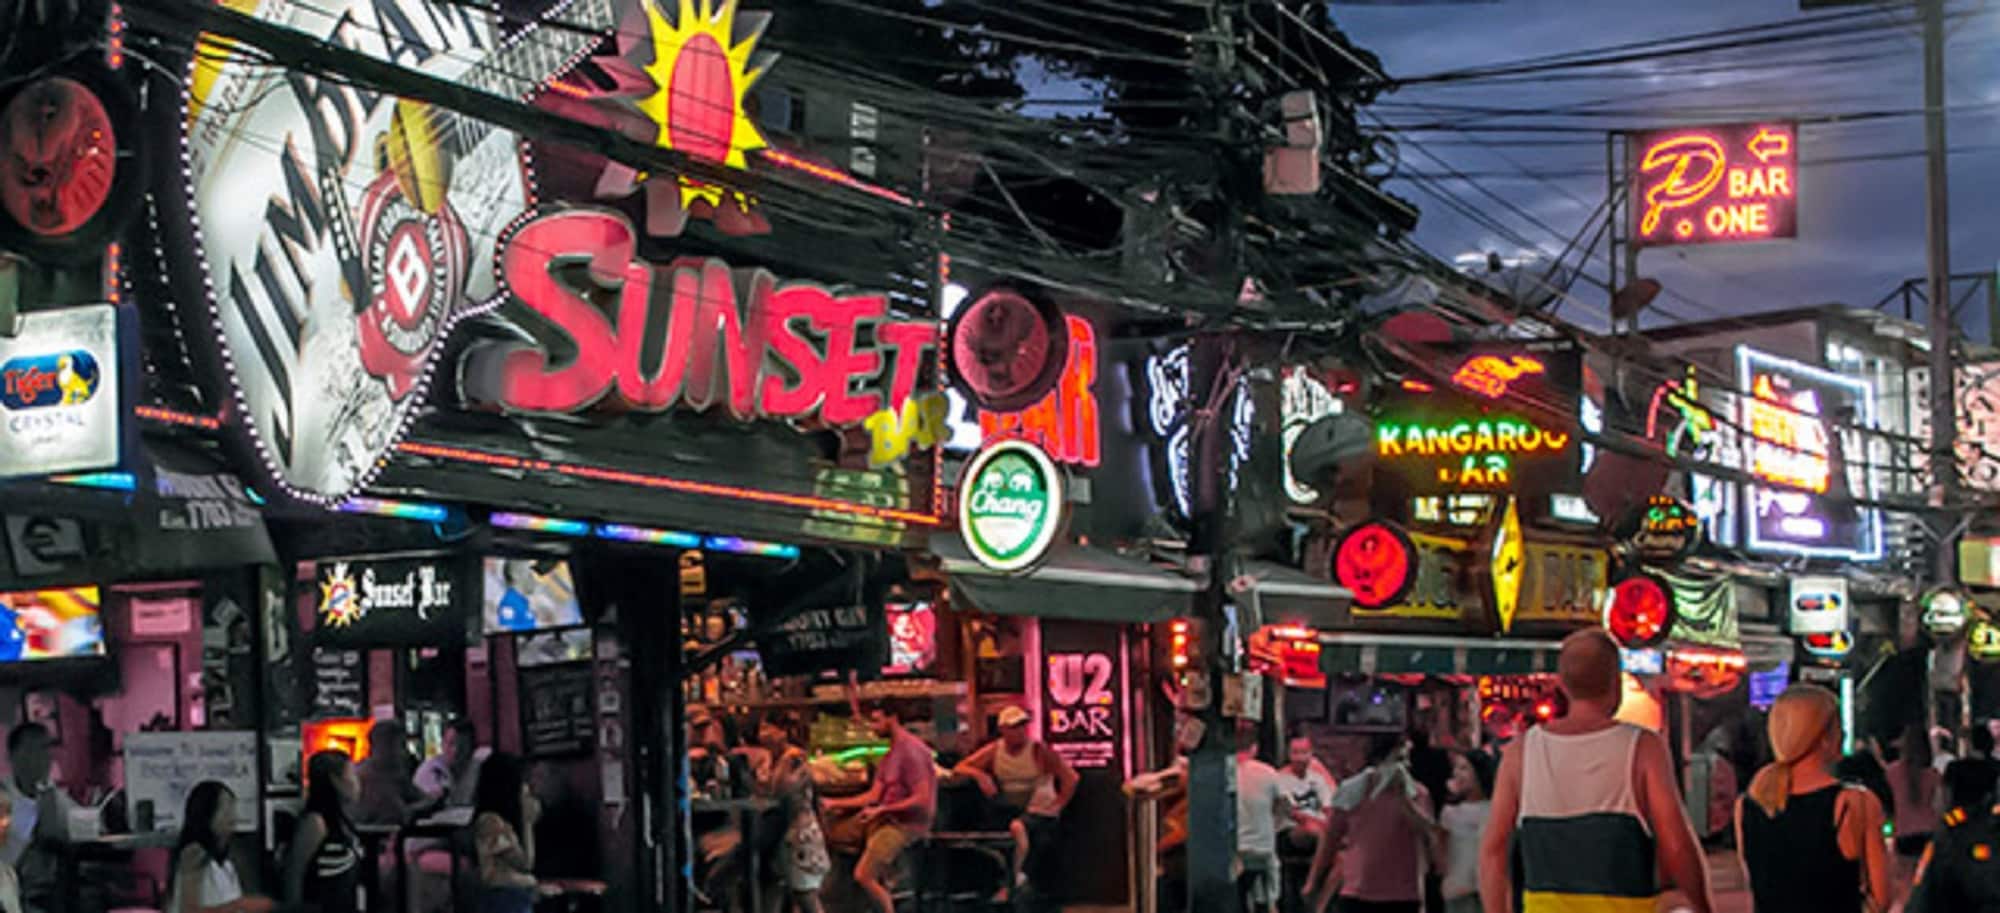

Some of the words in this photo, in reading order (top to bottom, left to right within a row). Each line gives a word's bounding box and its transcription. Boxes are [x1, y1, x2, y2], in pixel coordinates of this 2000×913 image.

[1728, 166, 1791, 198] BAR
[1705, 204, 1769, 236] ONE
[229, 130, 333, 469] JIM
[458, 205, 937, 422] SUNSET
[4, 366, 57, 404] Tiger
[864, 397, 950, 466] BAR
[971, 488, 1043, 522] Chang
[359, 567, 415, 617] Sunset
[418, 565, 450, 621] Bar
[1048, 653, 1113, 705] U2
[1050, 706, 1113, 736] BAR
